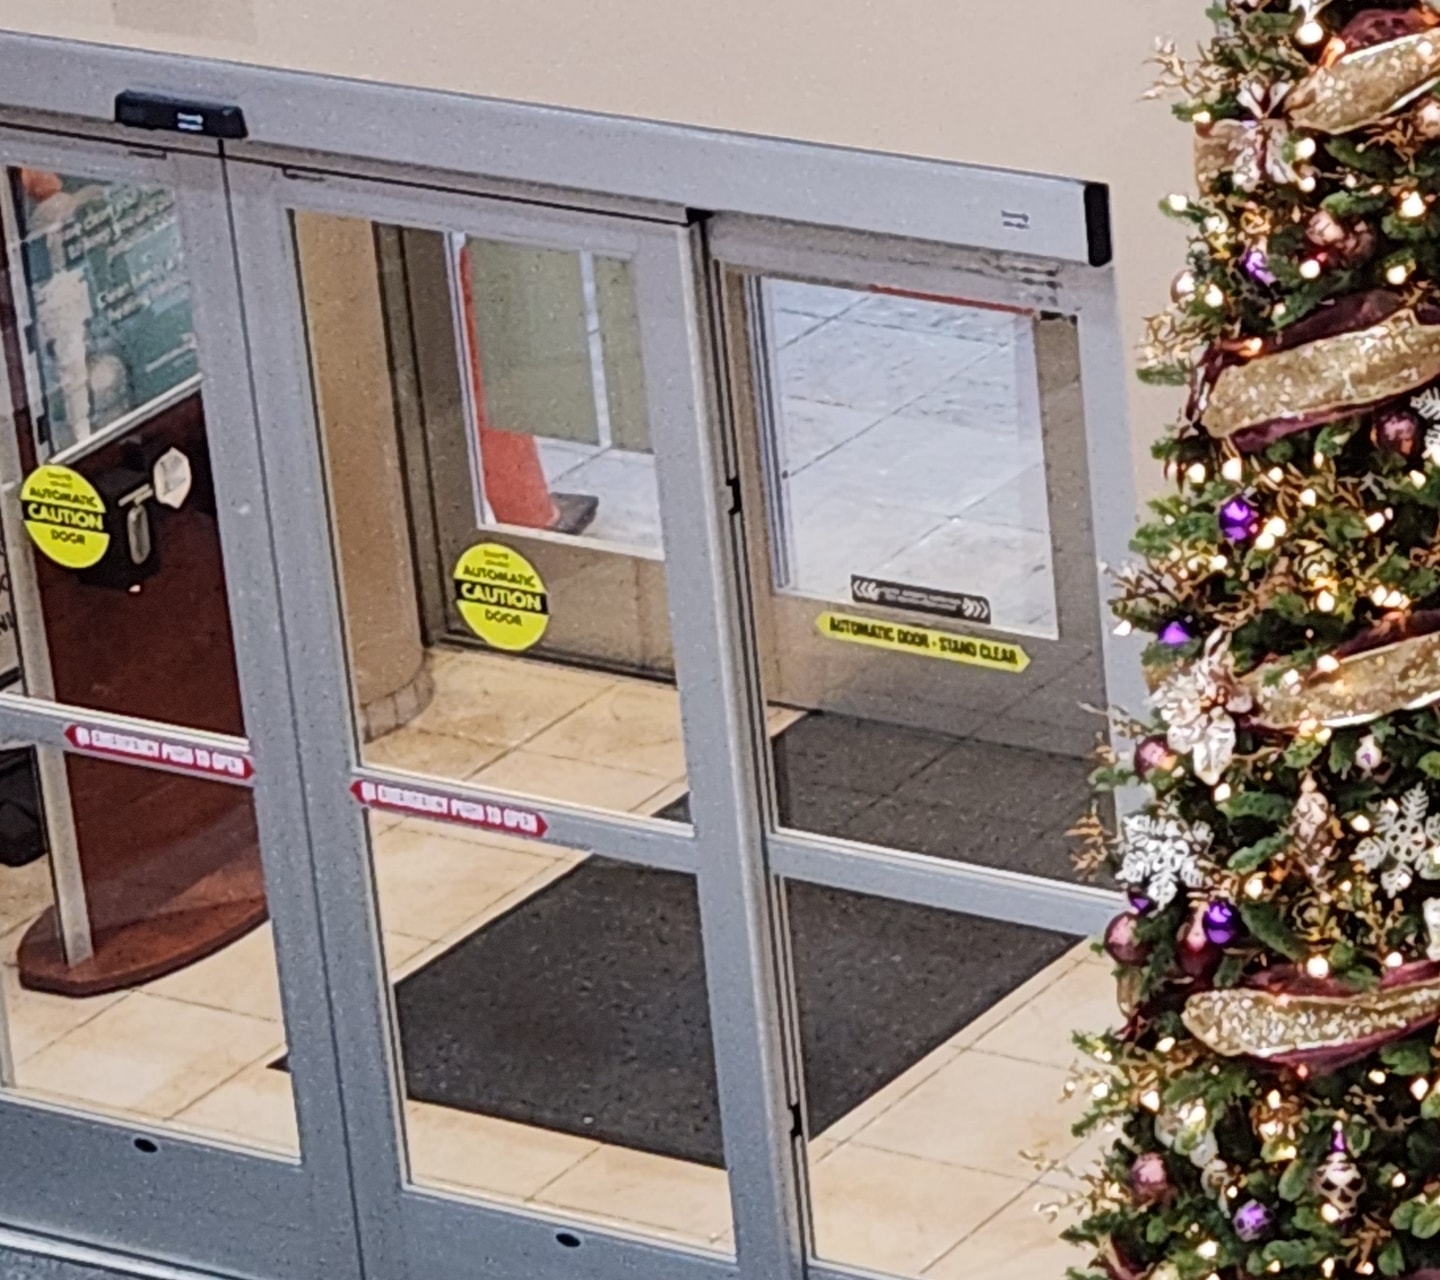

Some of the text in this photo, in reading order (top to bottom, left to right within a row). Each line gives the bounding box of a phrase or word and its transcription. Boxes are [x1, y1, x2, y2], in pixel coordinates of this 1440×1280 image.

[29, 487, 98, 508] AUTOMATIC
[27, 503, 104, 531] CAUTION
[463, 564, 536, 589] AUTOMATIC
[460, 582, 542, 611] CAUTION
[829, 616, 895, 642] AUTOMATIC
[897, 628, 929, 649] DOOR
[938, 636, 977, 657] STAND
[979, 643, 1018, 665] CLEAR
